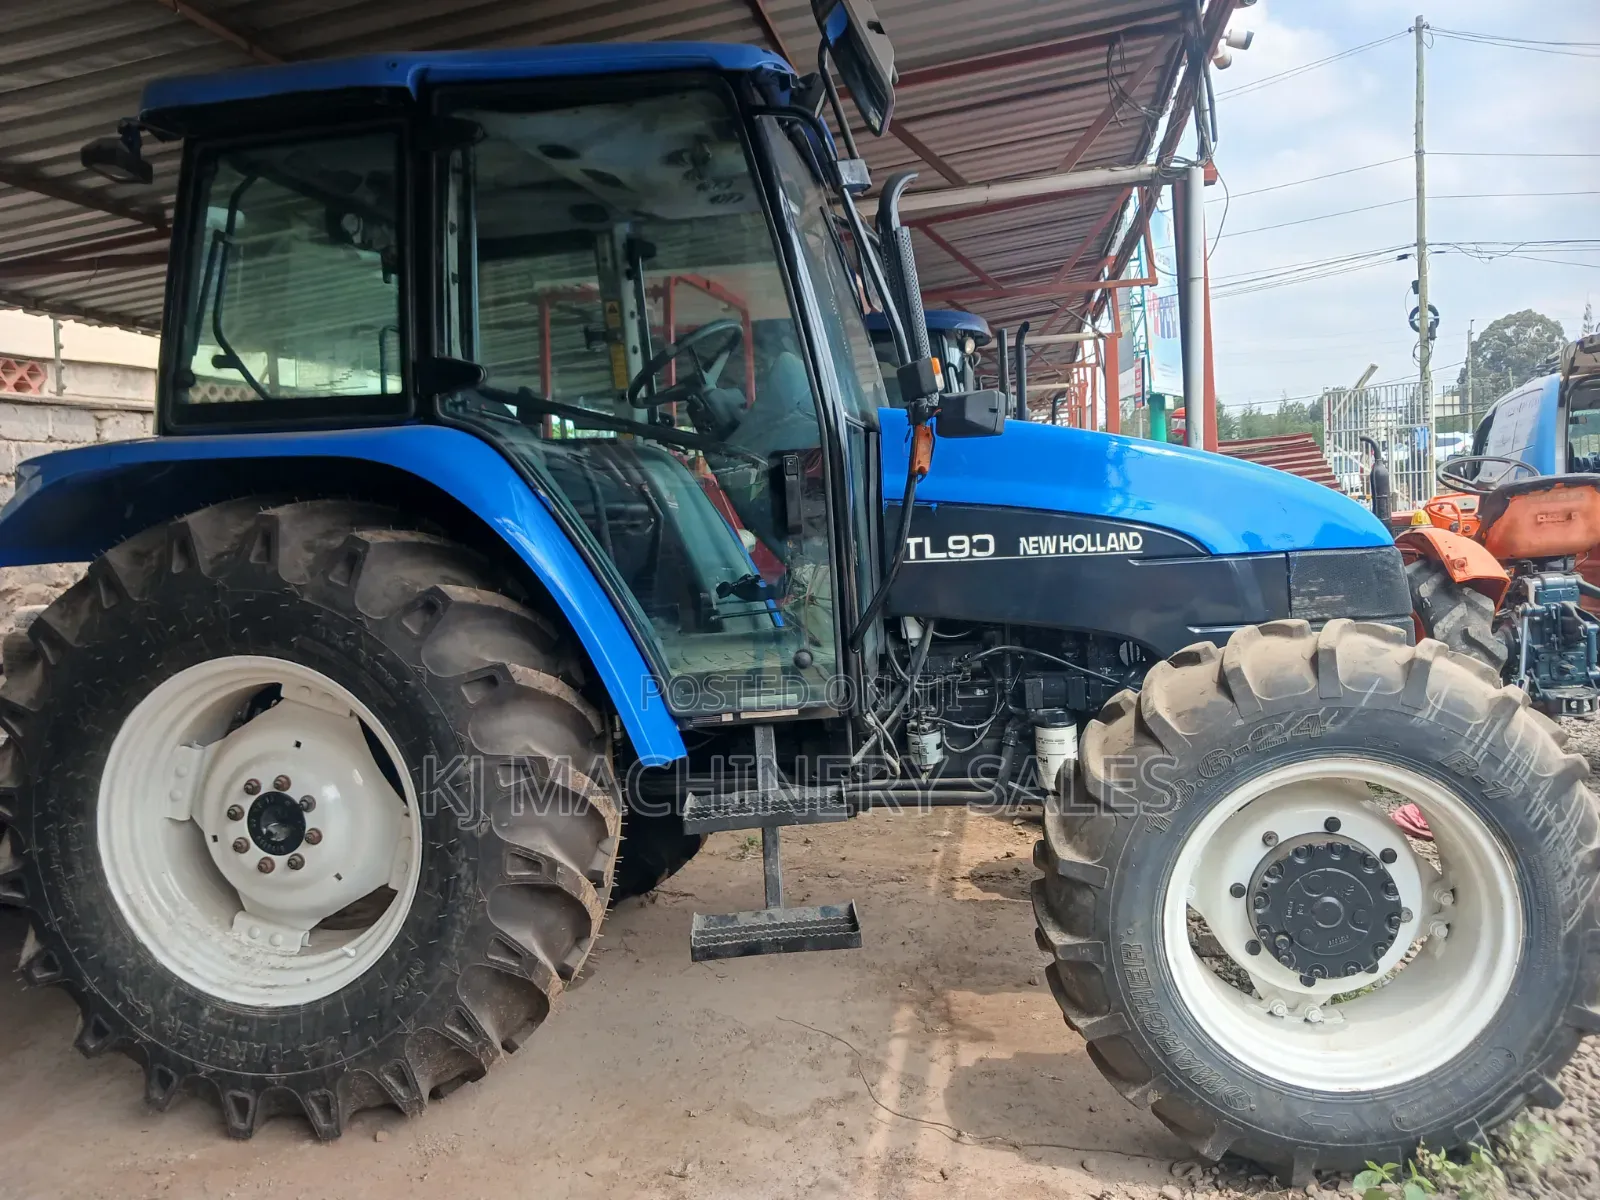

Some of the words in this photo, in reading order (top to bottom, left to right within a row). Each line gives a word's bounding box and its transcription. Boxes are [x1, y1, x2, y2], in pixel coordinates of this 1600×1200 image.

[1019, 535, 1057, 556] NEW
[1060, 532, 1143, 554] HOLLAND
[1120, 942, 1231, 1095] MARCHER
